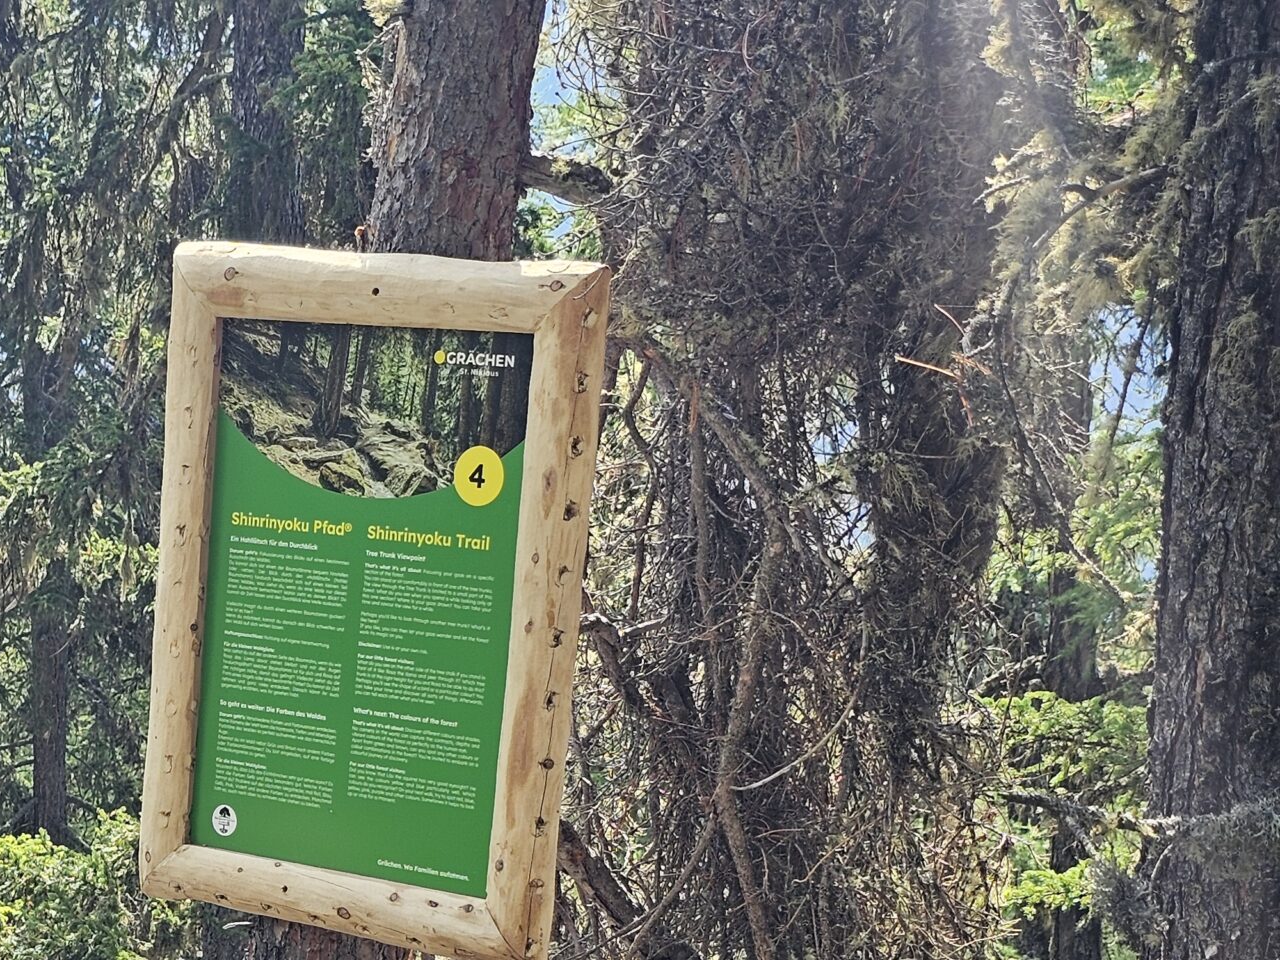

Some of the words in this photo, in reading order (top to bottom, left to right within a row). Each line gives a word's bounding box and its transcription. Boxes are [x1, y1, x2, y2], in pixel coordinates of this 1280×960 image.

[446, 350, 515, 367] GRÄCHEN
[469, 463, 485, 489] 4
[232, 512, 309, 533] Shinrinyoku
[367, 525, 451, 547] Shinrinyoku
[456, 534, 490, 550] Trail
[397, 553, 426, 562] Viewpoint
[353, 707, 373, 715] What's
[400, 714, 421, 722] colours
[440, 719, 458, 727] forest
